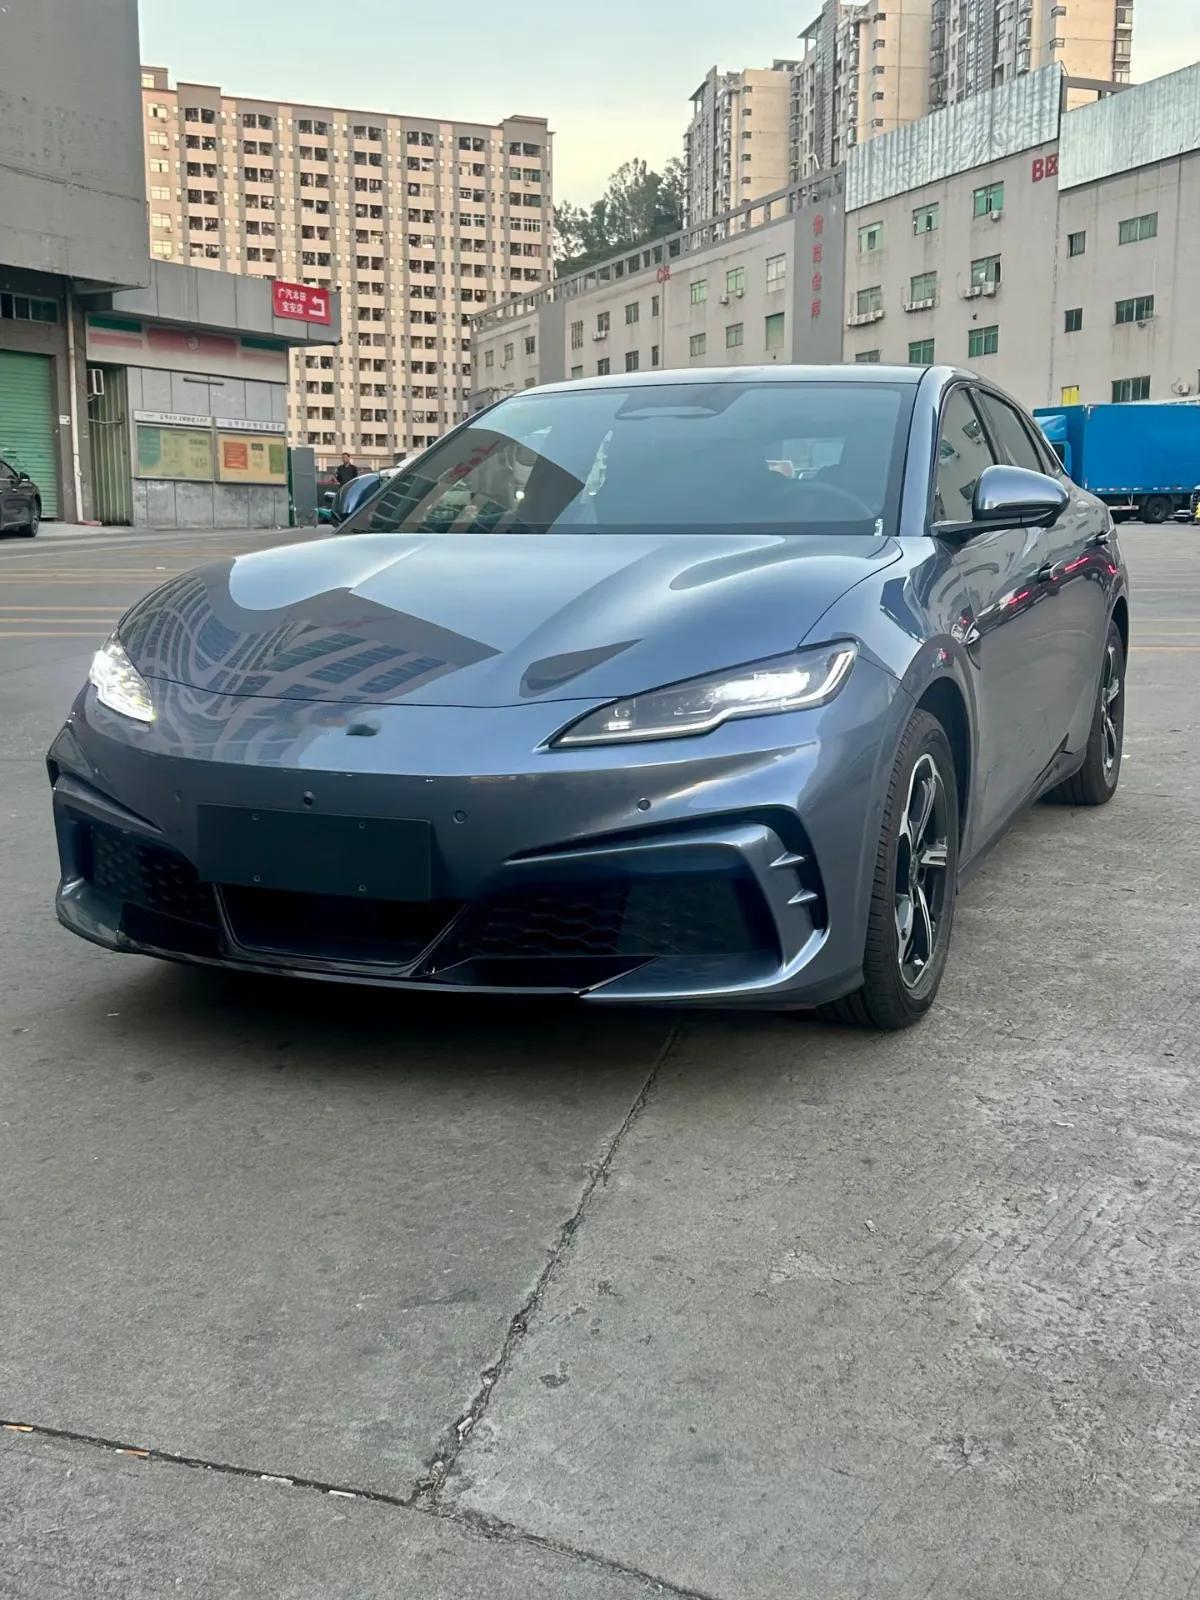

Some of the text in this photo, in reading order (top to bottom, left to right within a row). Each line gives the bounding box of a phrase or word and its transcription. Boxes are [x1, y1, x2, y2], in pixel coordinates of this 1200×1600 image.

[1032, 154, 1059, 182] B区
[278, 288, 307, 302] 广汽本田
[282, 301, 304, 314] 宝安店
